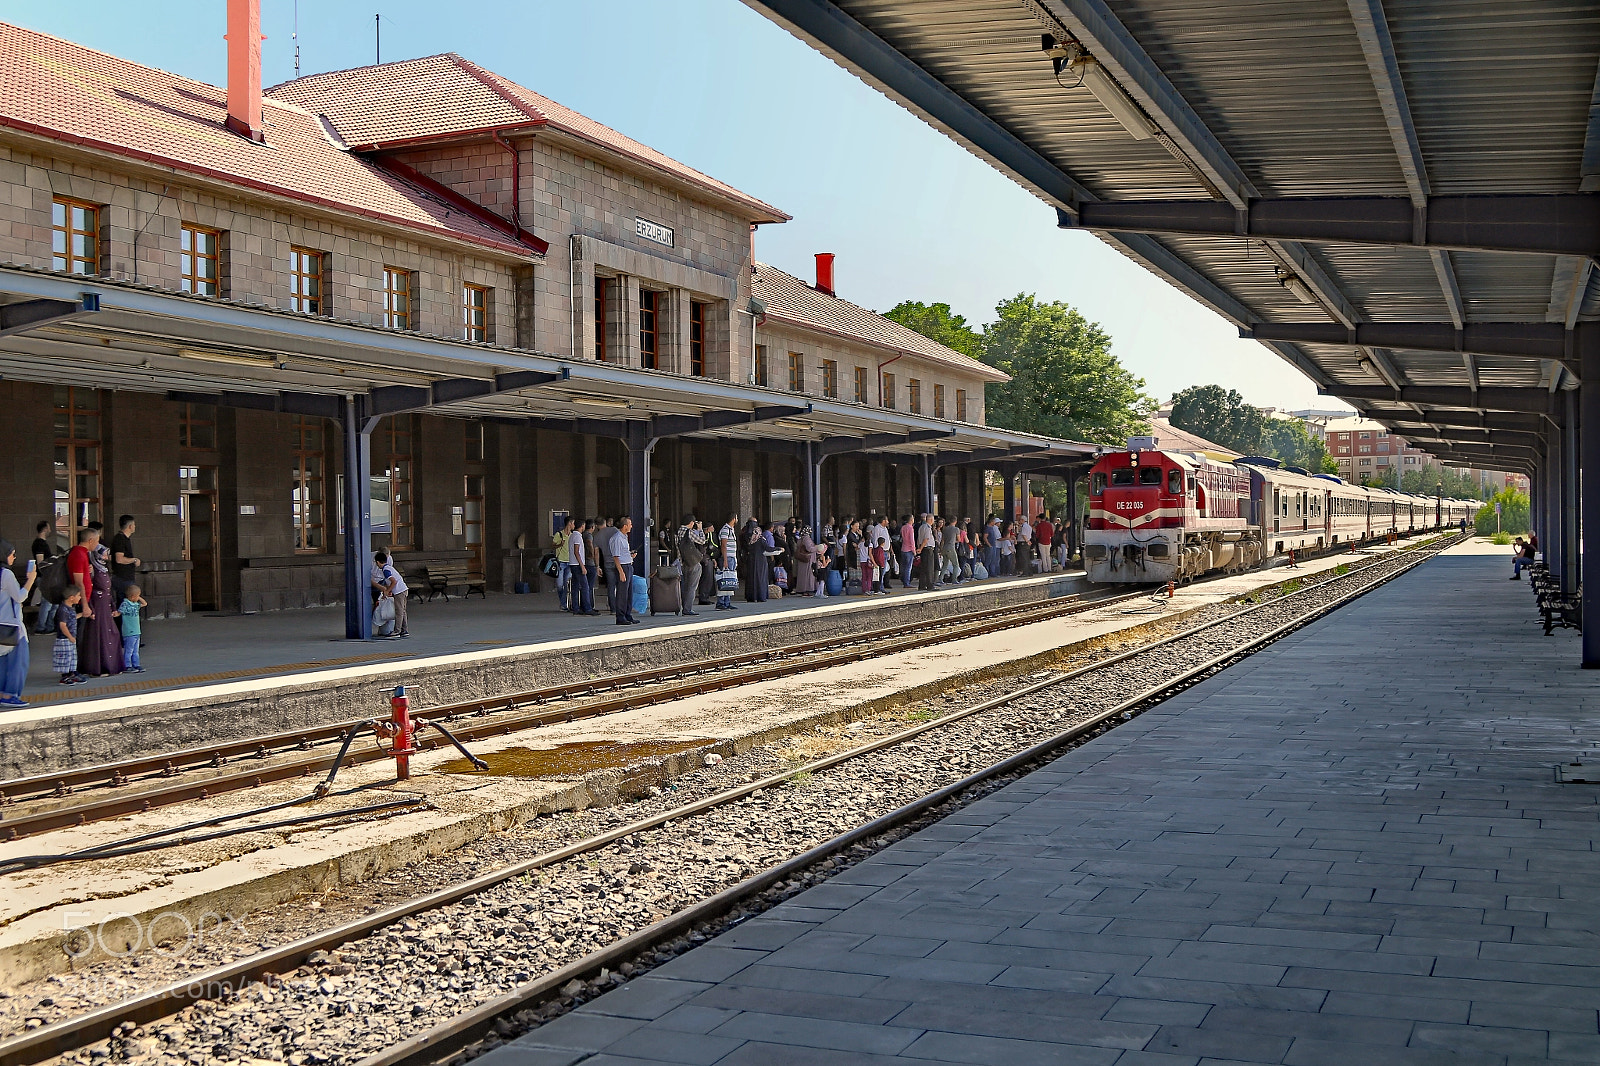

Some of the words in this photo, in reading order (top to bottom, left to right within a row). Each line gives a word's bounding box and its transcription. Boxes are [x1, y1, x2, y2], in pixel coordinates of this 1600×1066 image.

[1116, 501, 1125, 510] DE
[1125, 501, 1133, 510] 22
[1133, 501, 1144, 510] 035
